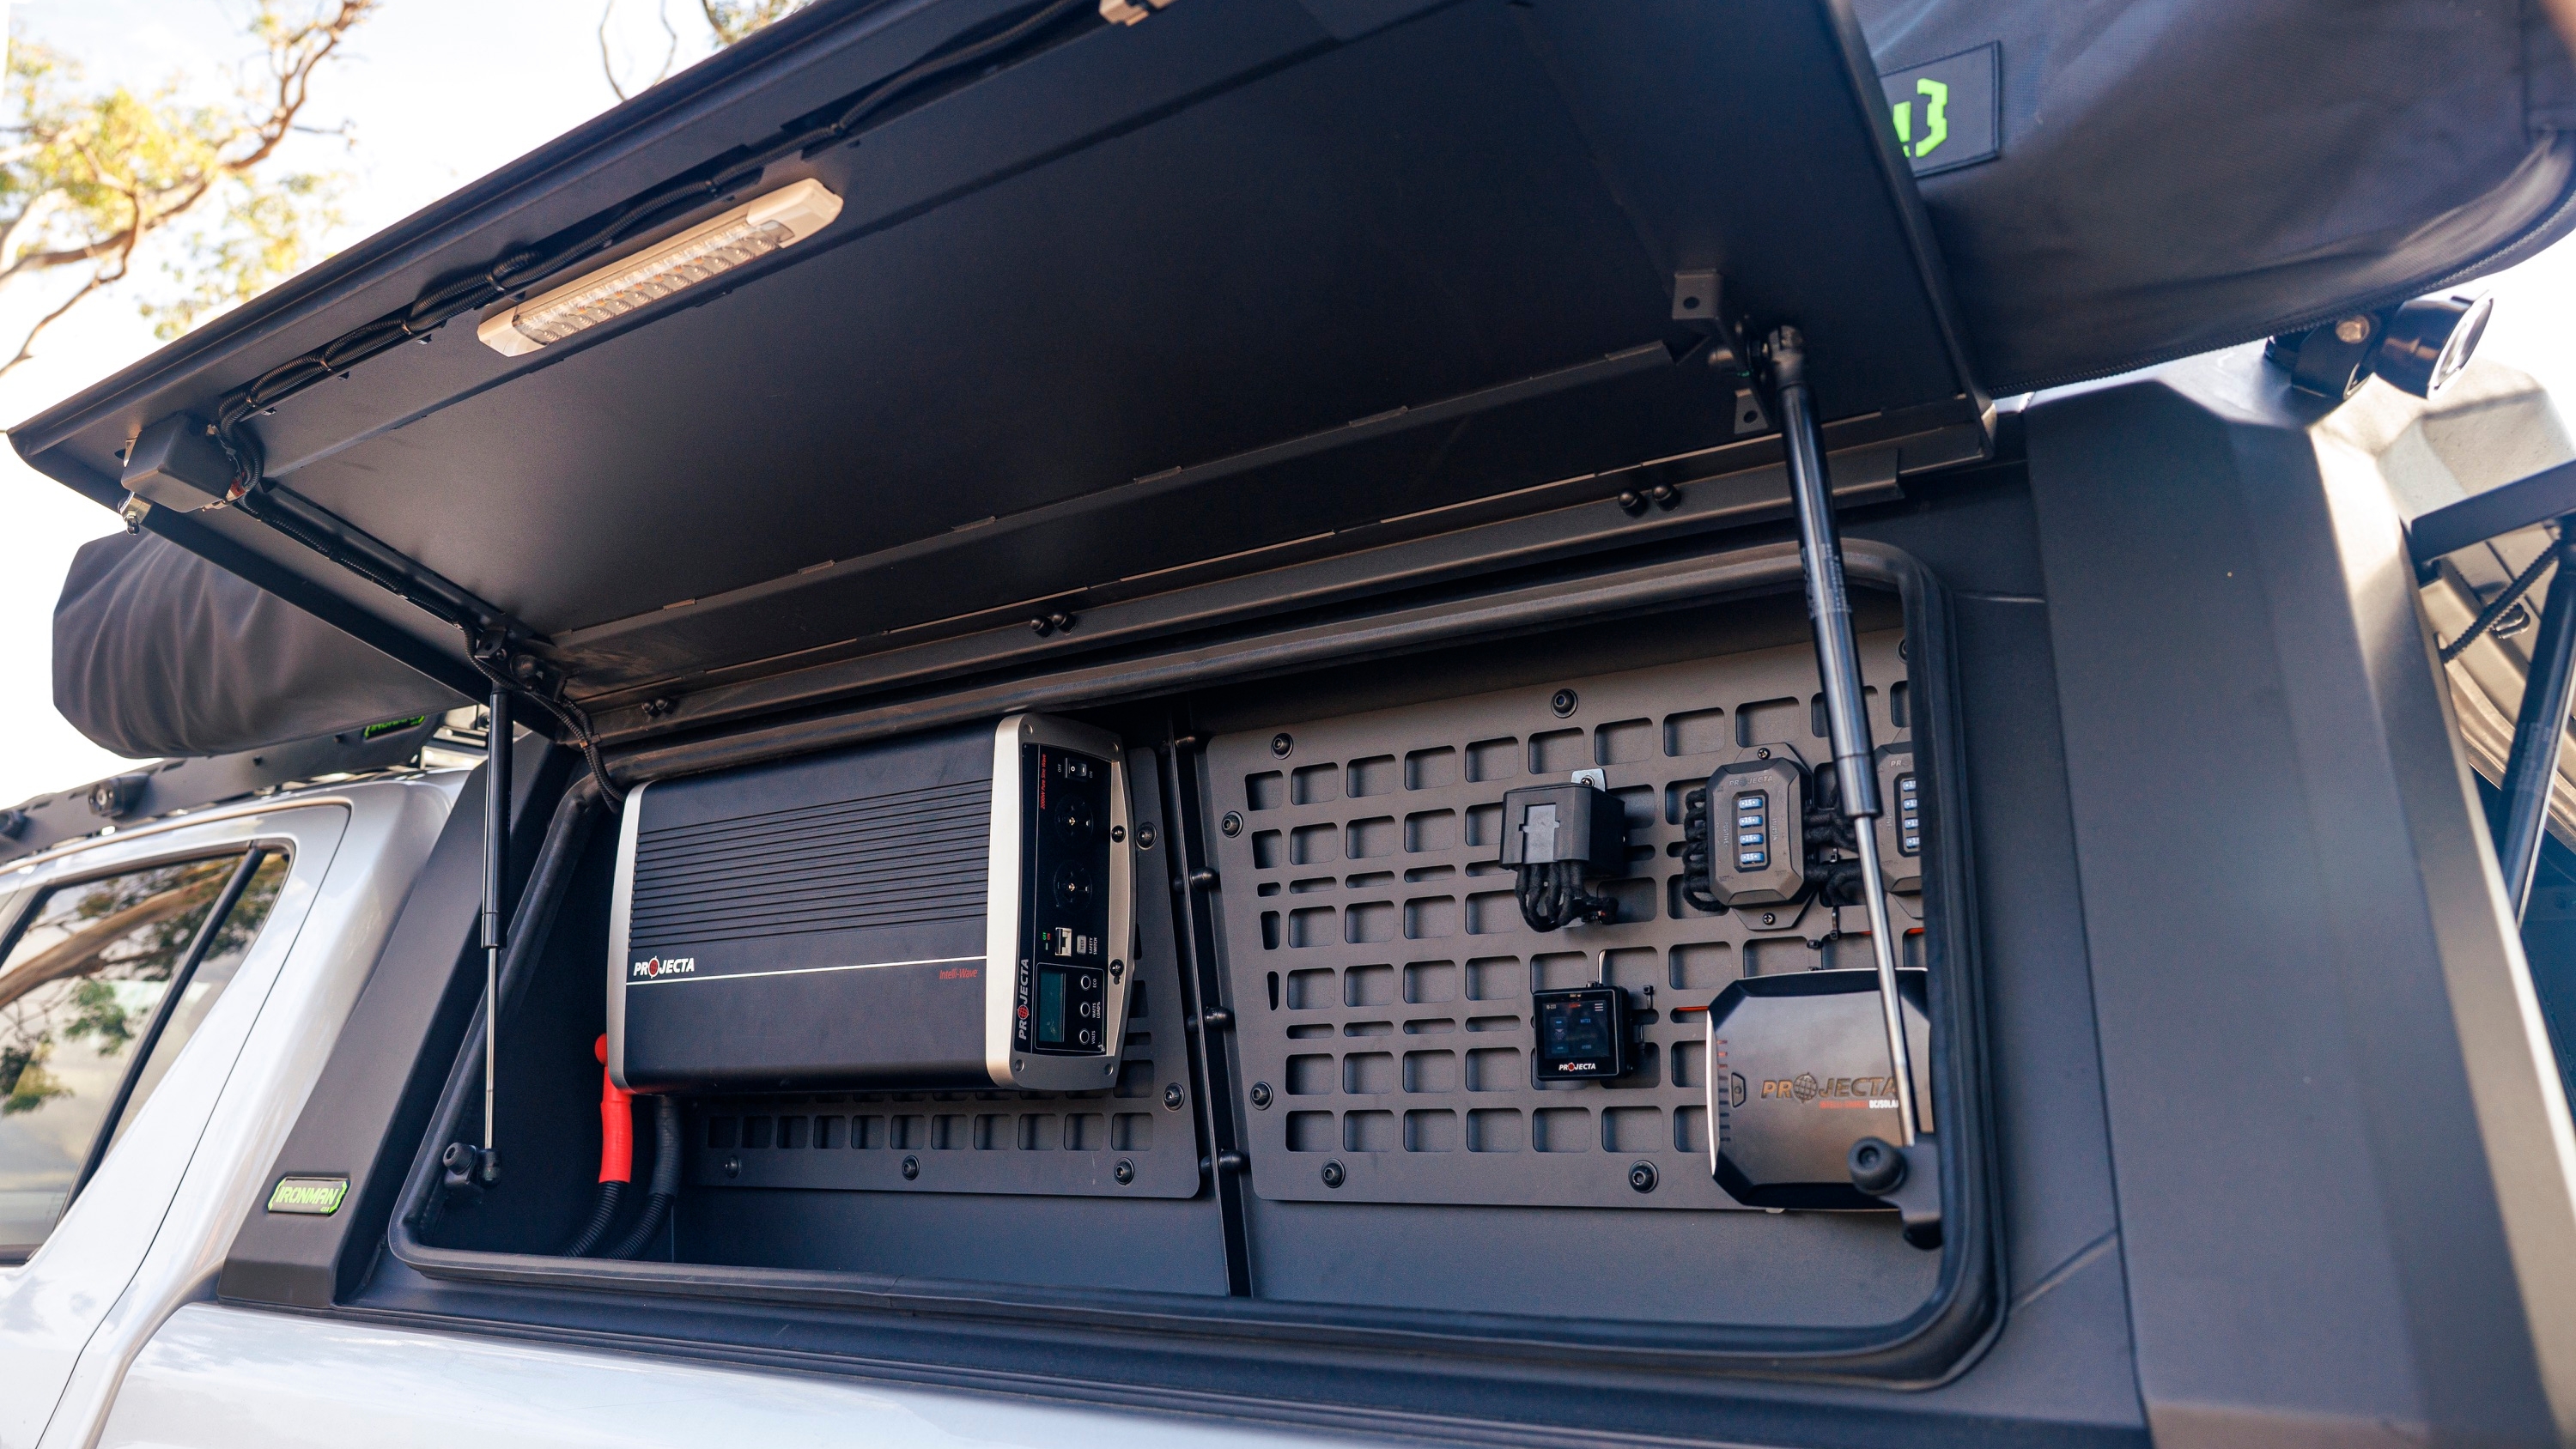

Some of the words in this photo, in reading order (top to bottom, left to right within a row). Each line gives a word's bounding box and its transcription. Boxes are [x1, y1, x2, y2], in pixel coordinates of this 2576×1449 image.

[1728, 776, 1773, 787] PROJECTA
[633, 955, 695, 979] PROJECTA
[939, 968, 978, 979] Intelli-Wave
[1018, 959, 1029, 1040] PROJECTA
[1558, 1063, 1596, 1071] PROJECTA
[1761, 1074, 1898, 1101] PROJECTA
[275, 1187, 339, 1205] IRONMAN
